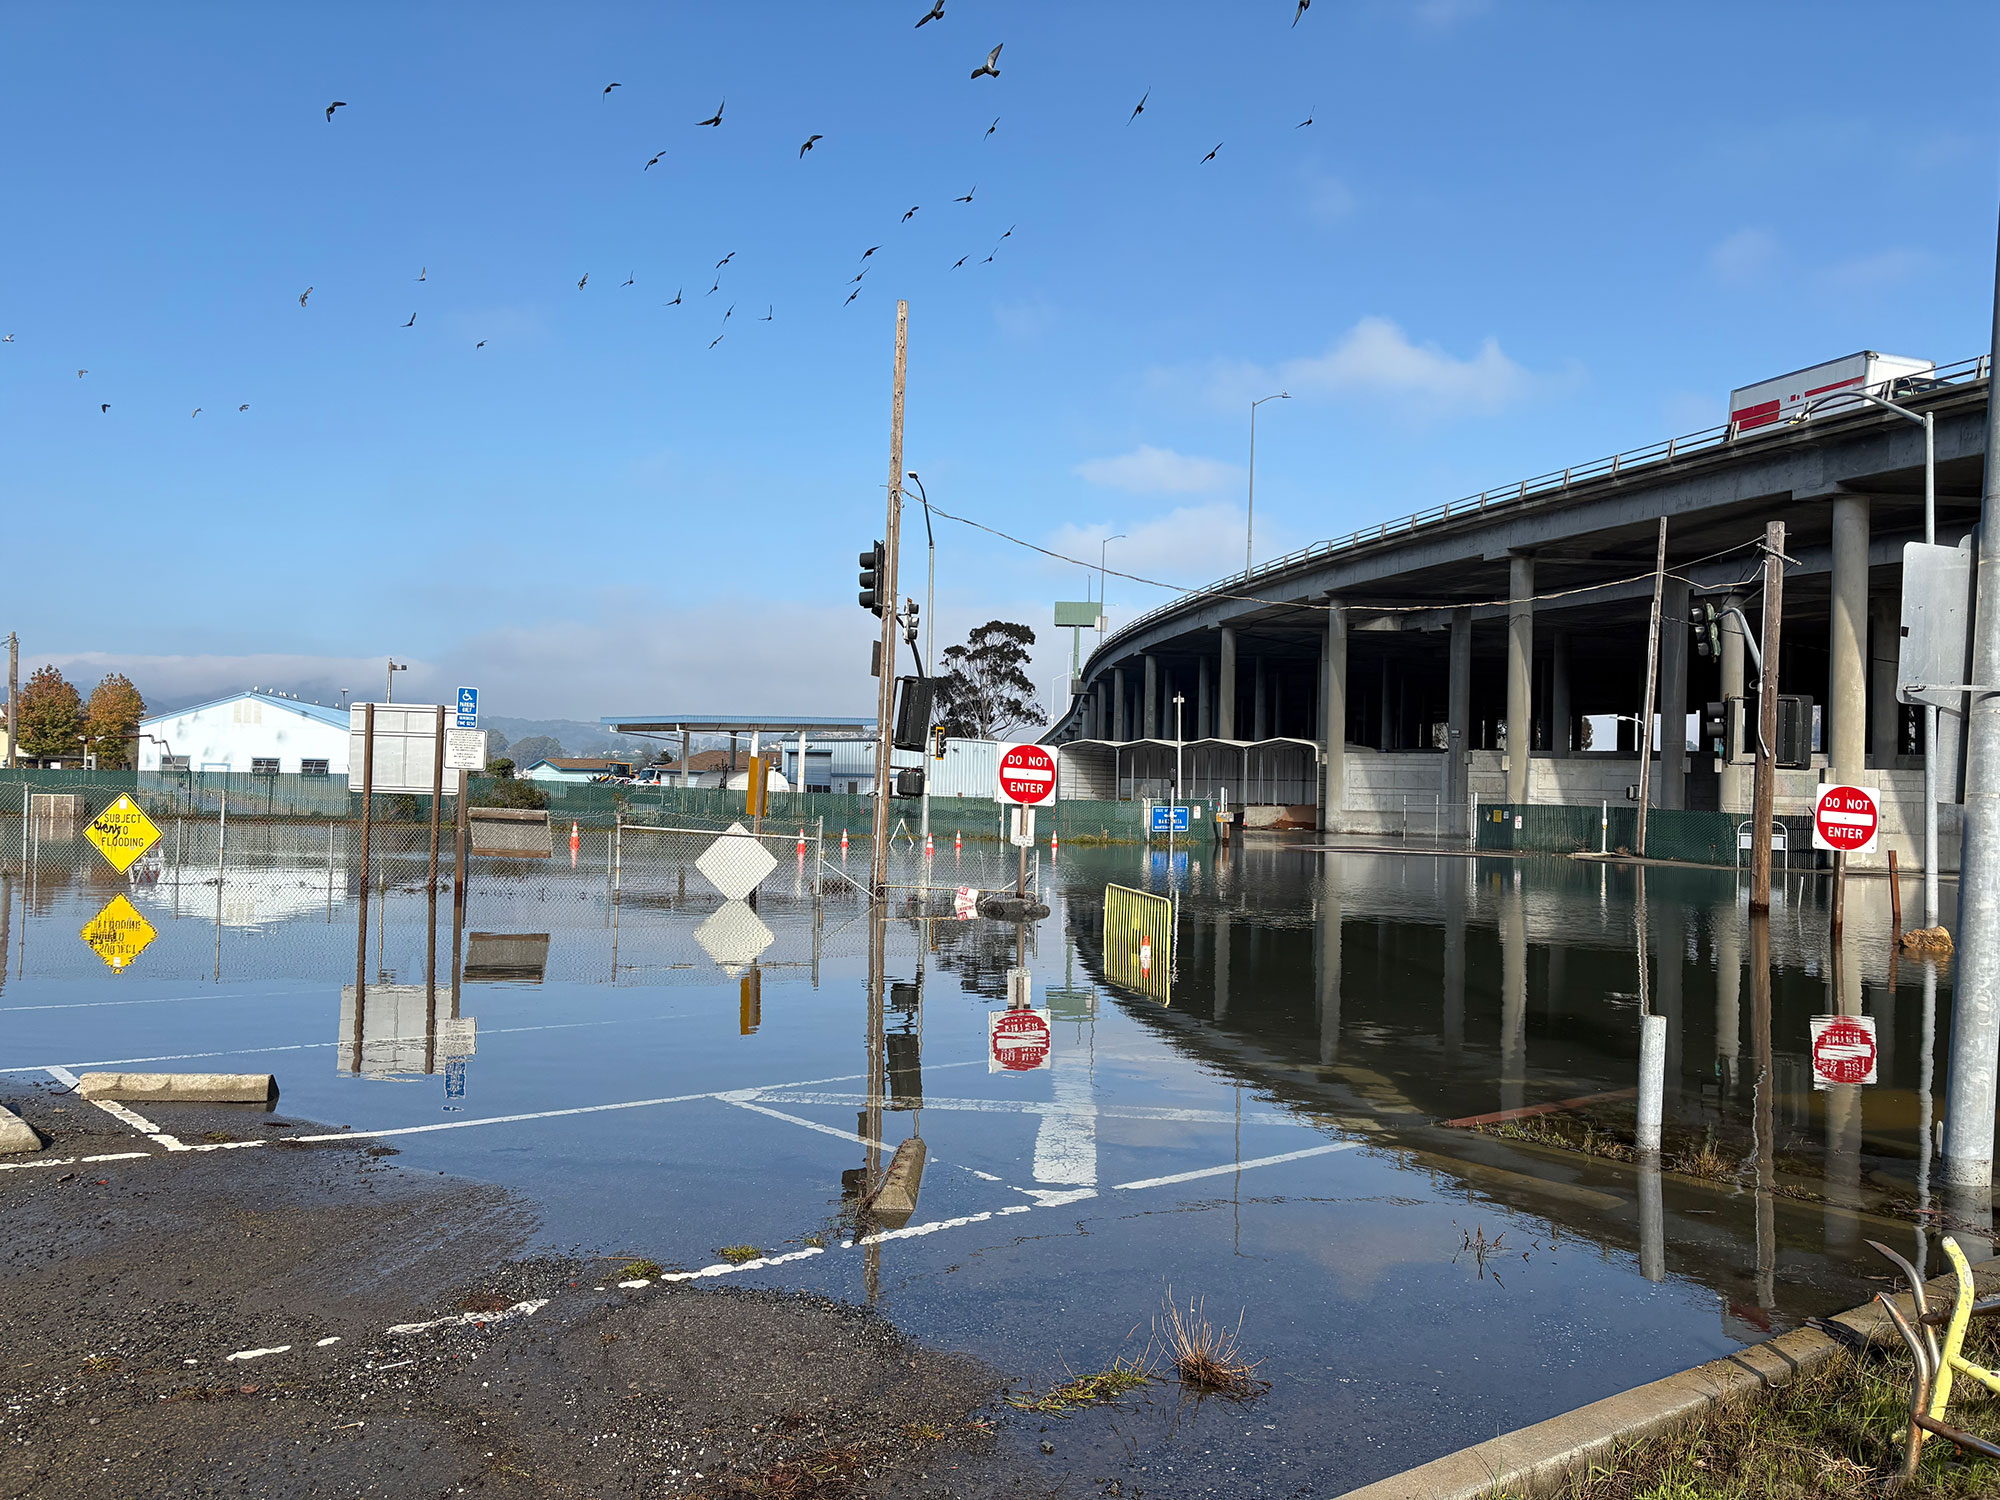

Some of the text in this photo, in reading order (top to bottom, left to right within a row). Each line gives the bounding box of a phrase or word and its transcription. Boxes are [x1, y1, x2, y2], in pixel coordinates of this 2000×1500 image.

[1008, 754, 1049, 767] DO NOT
[1010, 782, 1044, 793] ENTER
[1825, 796, 1870, 811] DO NOT
[104, 812, 142, 823] SUBJECT
[1828, 826, 1863, 839] ENTER
[101, 837, 144, 847] FLOODING
